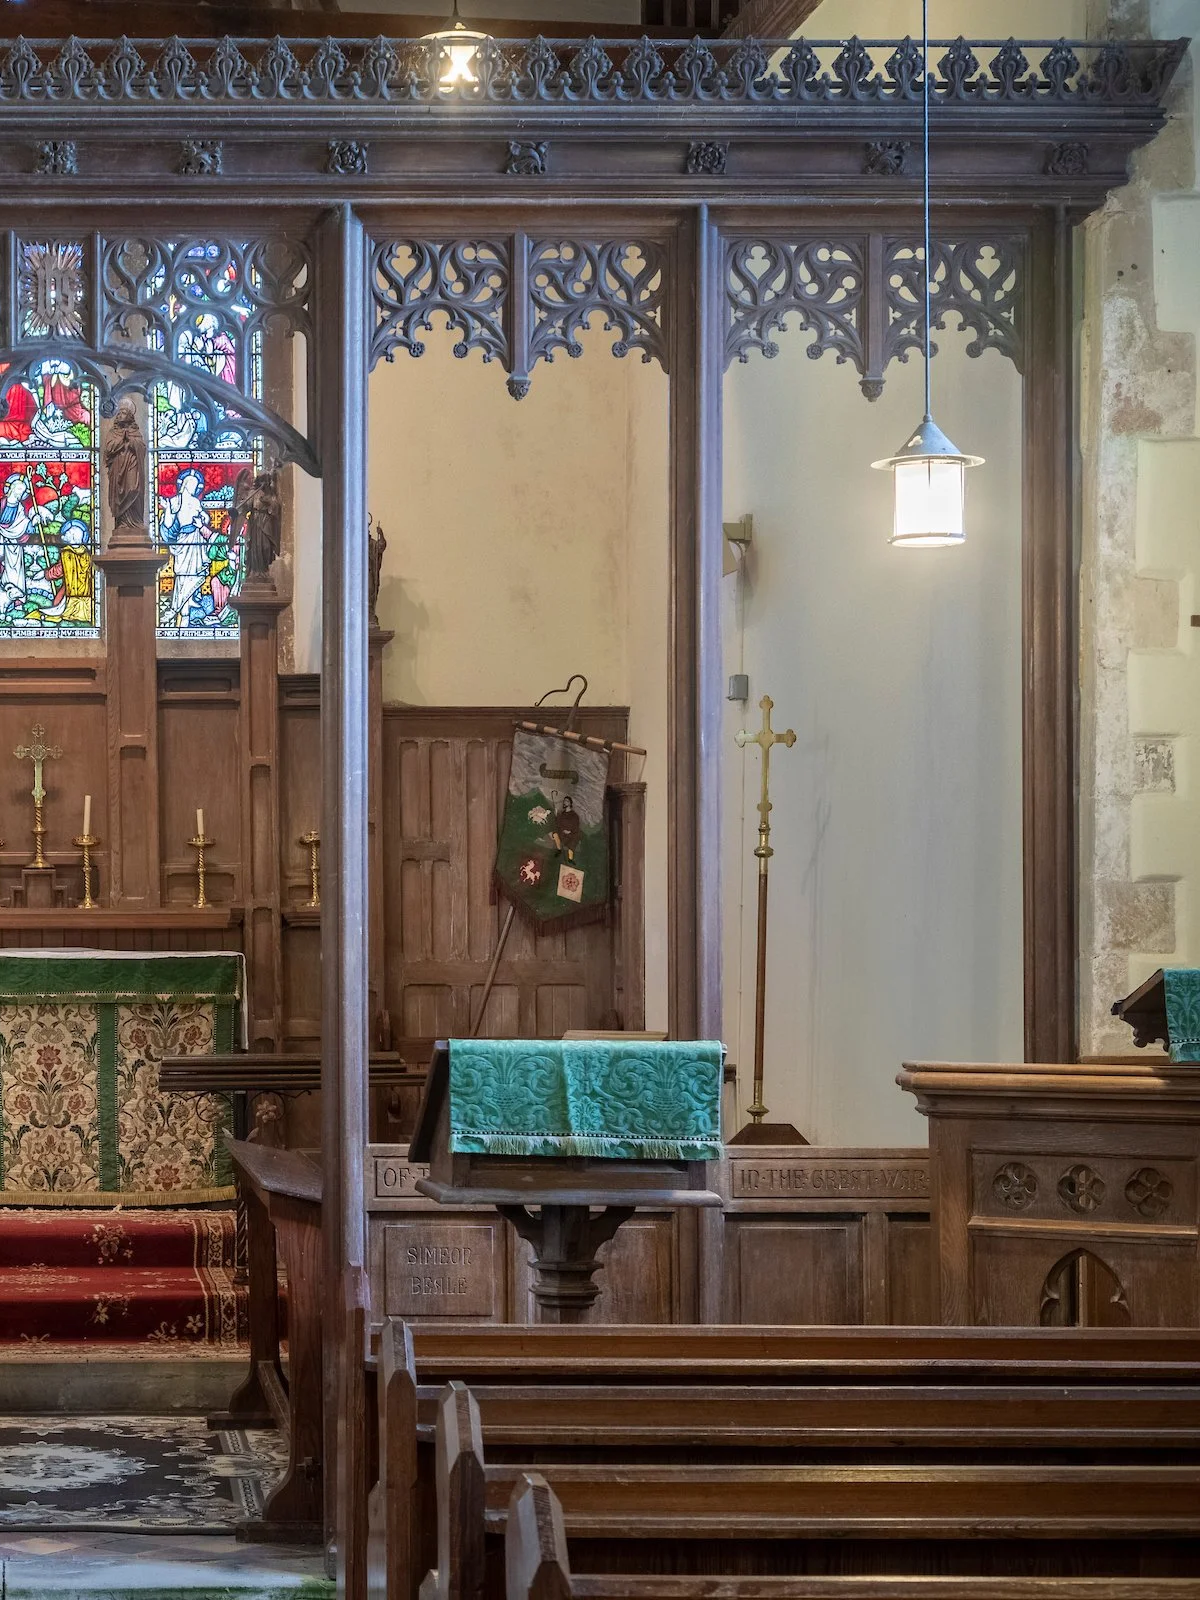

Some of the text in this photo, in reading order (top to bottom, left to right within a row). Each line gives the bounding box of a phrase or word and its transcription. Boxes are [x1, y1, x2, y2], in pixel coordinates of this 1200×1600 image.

[383, 1167, 411, 1188] OF
[740, 1168, 759, 1190] IN
[766, 1168, 805, 1190] THE
[811, 1168, 874, 1190] GREAT
[406, 1246, 472, 1266] SIMEON
[411, 1276, 469, 1296] BEALE
